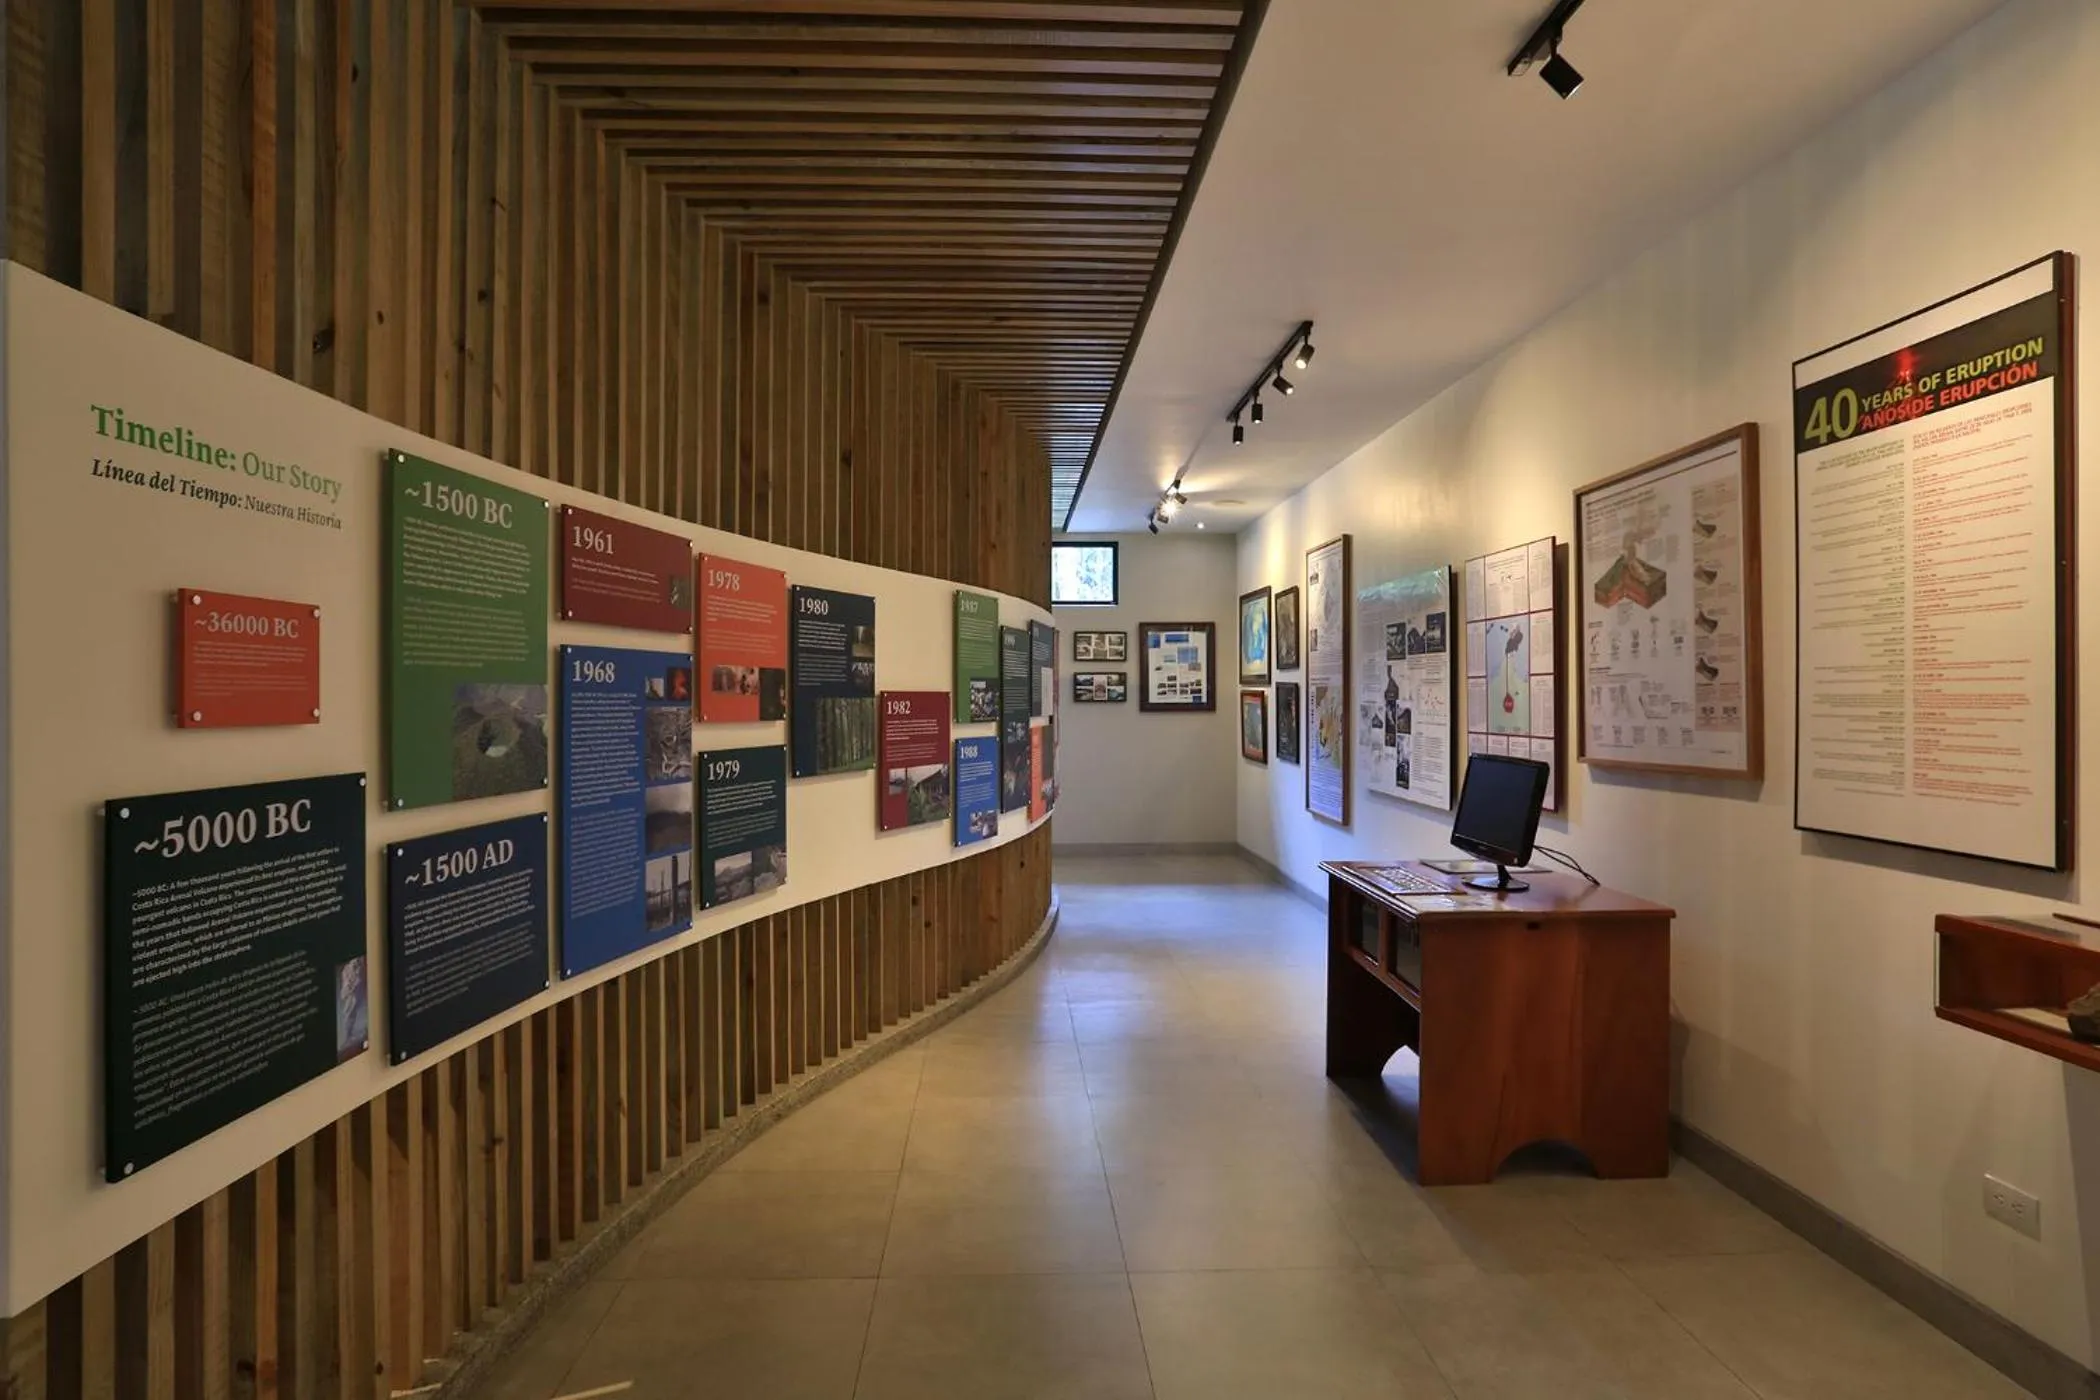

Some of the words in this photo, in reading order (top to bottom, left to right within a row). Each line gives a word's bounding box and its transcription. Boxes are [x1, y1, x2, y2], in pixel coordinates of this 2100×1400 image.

[1804, 387, 1858, 445] 40
[1861, 382, 1914, 410] YEARS
[1919, 371, 1941, 393] OF
[1946, 336, 2044, 385] ERUPTION
[1860, 404, 1907, 430] AÑOS
[1912, 396, 1935, 414] DE
[1940, 362, 2038, 407] ERUPCIÓN
[90, 404, 237, 472] Timeline:
[243, 451, 285, 484] Our
[289, 464, 342, 503] Story
[90, 458, 145, 487] Línea
[150, 470, 176, 493] del
[178, 479, 242, 509] Tiempo:
[244, 496, 294, 520] Nuestra
[296, 507, 342, 530] Historia
[404, 481, 478, 520] ~1500
[483, 498, 513, 529] BC
[572, 525, 614, 555] 1961
[707, 569, 741, 591] 1978
[194, 612, 269, 636] ~36000
[274, 618, 300, 639] BC
[799, 597, 829, 616] 1980
[572, 659, 615, 684] 1968
[886, 700, 911, 715] 1982
[707, 759, 740, 781] 1979
[133, 807, 257, 859] ~5000
[266, 798, 312, 838] BC
[404, 847, 478, 887] ~1500
[482, 839, 514, 870] AD
